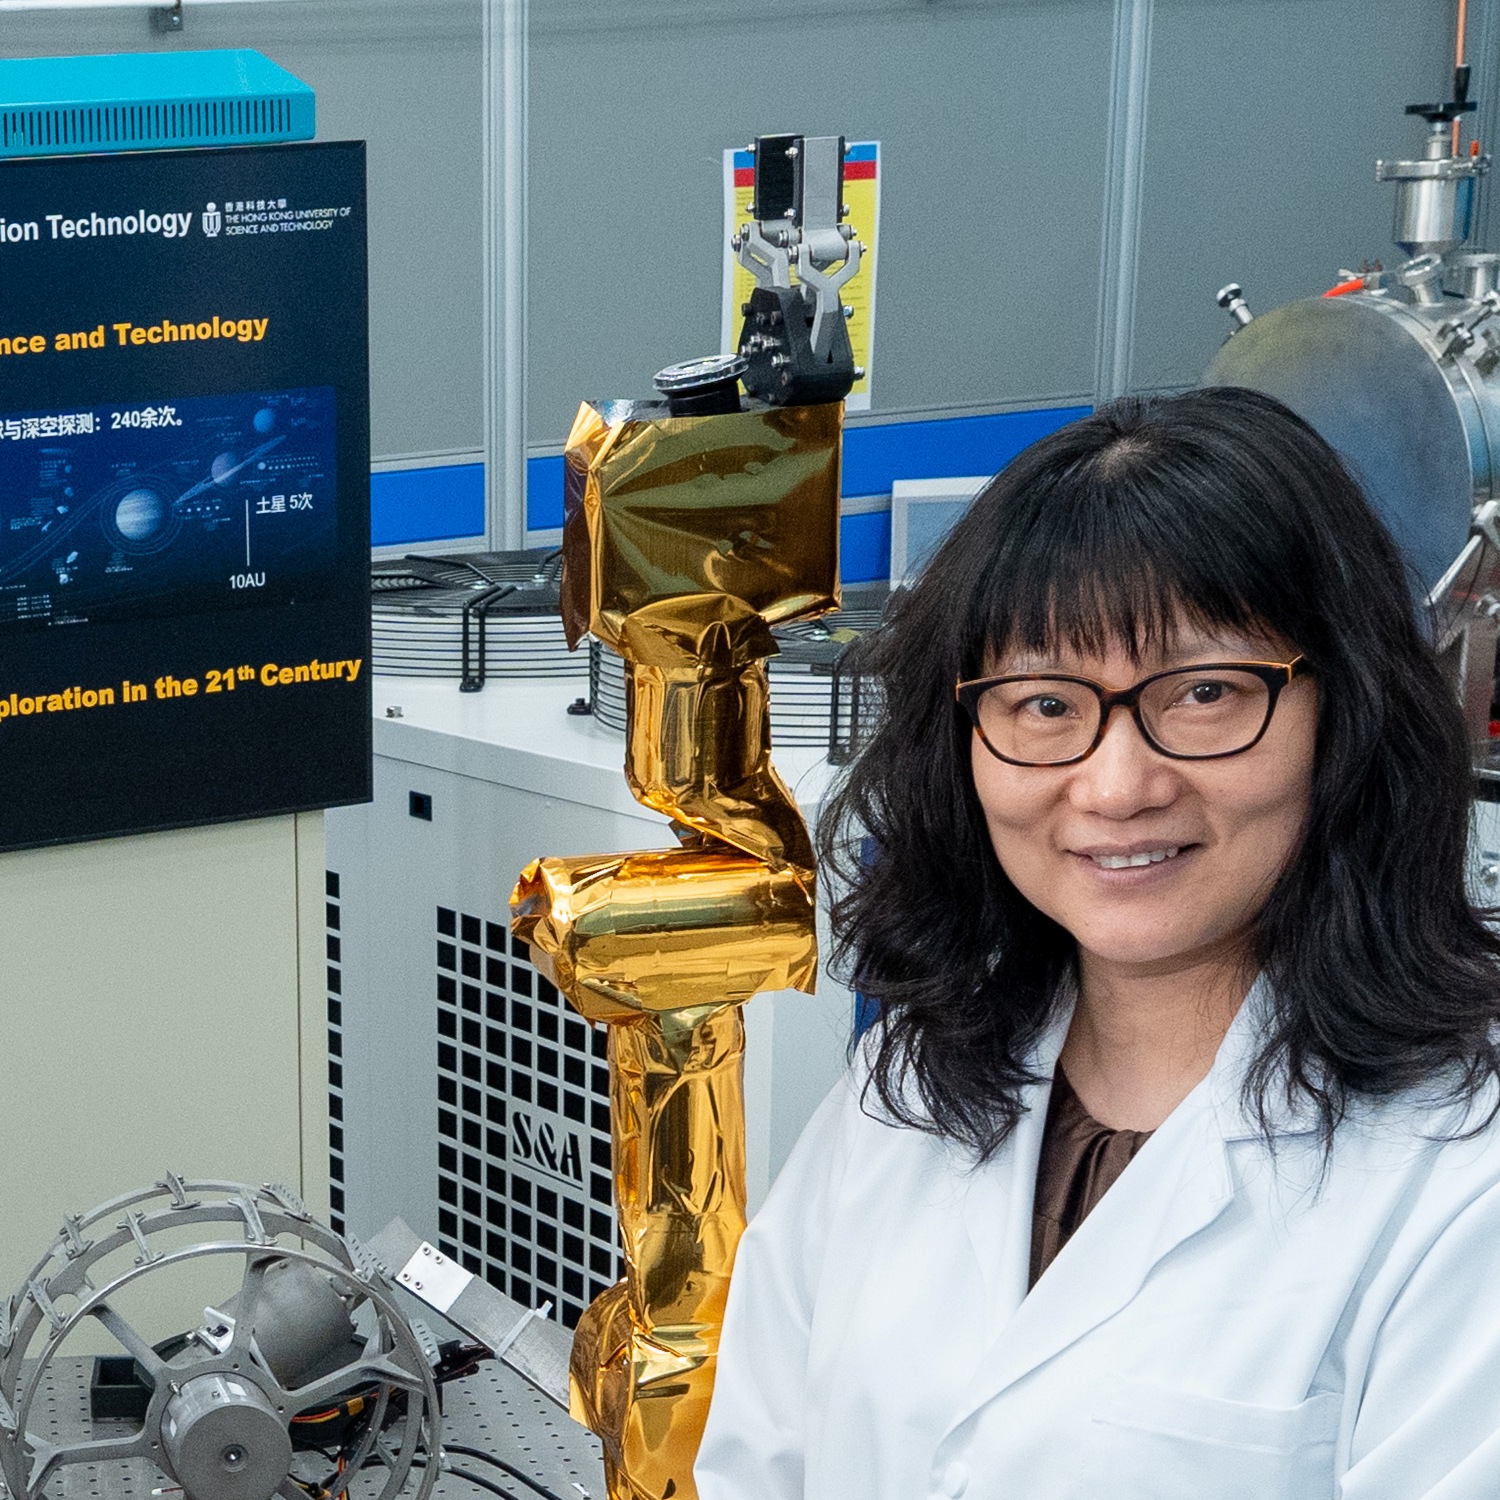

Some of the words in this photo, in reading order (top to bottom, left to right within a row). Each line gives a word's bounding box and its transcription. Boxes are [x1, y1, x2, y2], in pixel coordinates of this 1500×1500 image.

[225, 198, 287, 213] 香港科技大學
[226, 214, 240, 224] THE
[241, 212, 267, 223] HONG
[269, 211, 294, 221] KONG
[296, 208, 338, 219] UNIVERSITY
[340, 207, 351, 217] OF
[45, 209, 193, 240] Technology
[226, 225, 258, 236] SCIENCE
[260, 223, 279, 234] AND
[280, 220, 333, 232] TECHNOLOGY
[55, 325, 105, 351] and
[113, 316, 269, 346] Technology
[255, 495, 286, 514] 土星
[289, 492, 313, 511] 5次
[229, 572, 266, 589] 10AU
[122, 680, 147, 703] in
[154, 675, 198, 699] the
[260, 658, 362, 687] Century
[513, 1111, 583, 1183] S&A
